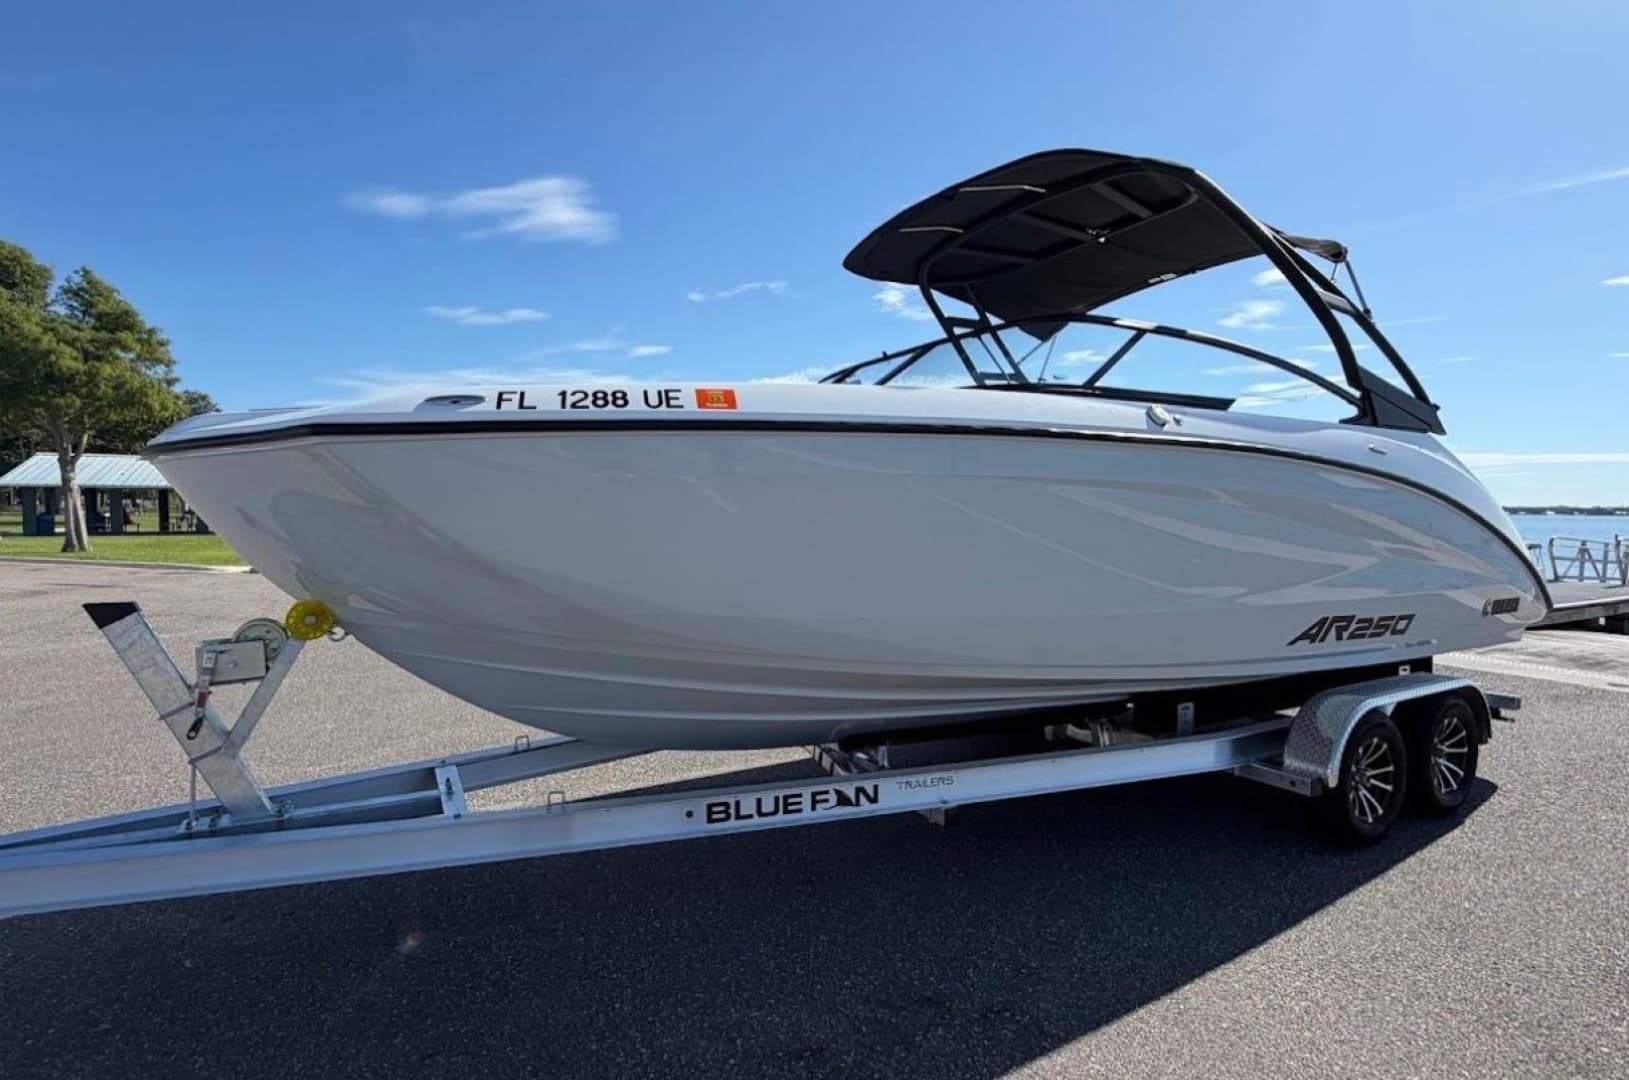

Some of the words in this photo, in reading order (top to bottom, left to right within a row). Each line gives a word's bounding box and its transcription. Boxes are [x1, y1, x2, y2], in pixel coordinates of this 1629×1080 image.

[496, 390, 537, 410] FL
[557, 389, 630, 409] 1288
[643, 389, 685, 409] UE
[1287, 614, 1415, 645] AR250
[896, 776, 954, 790] TRAILERS
